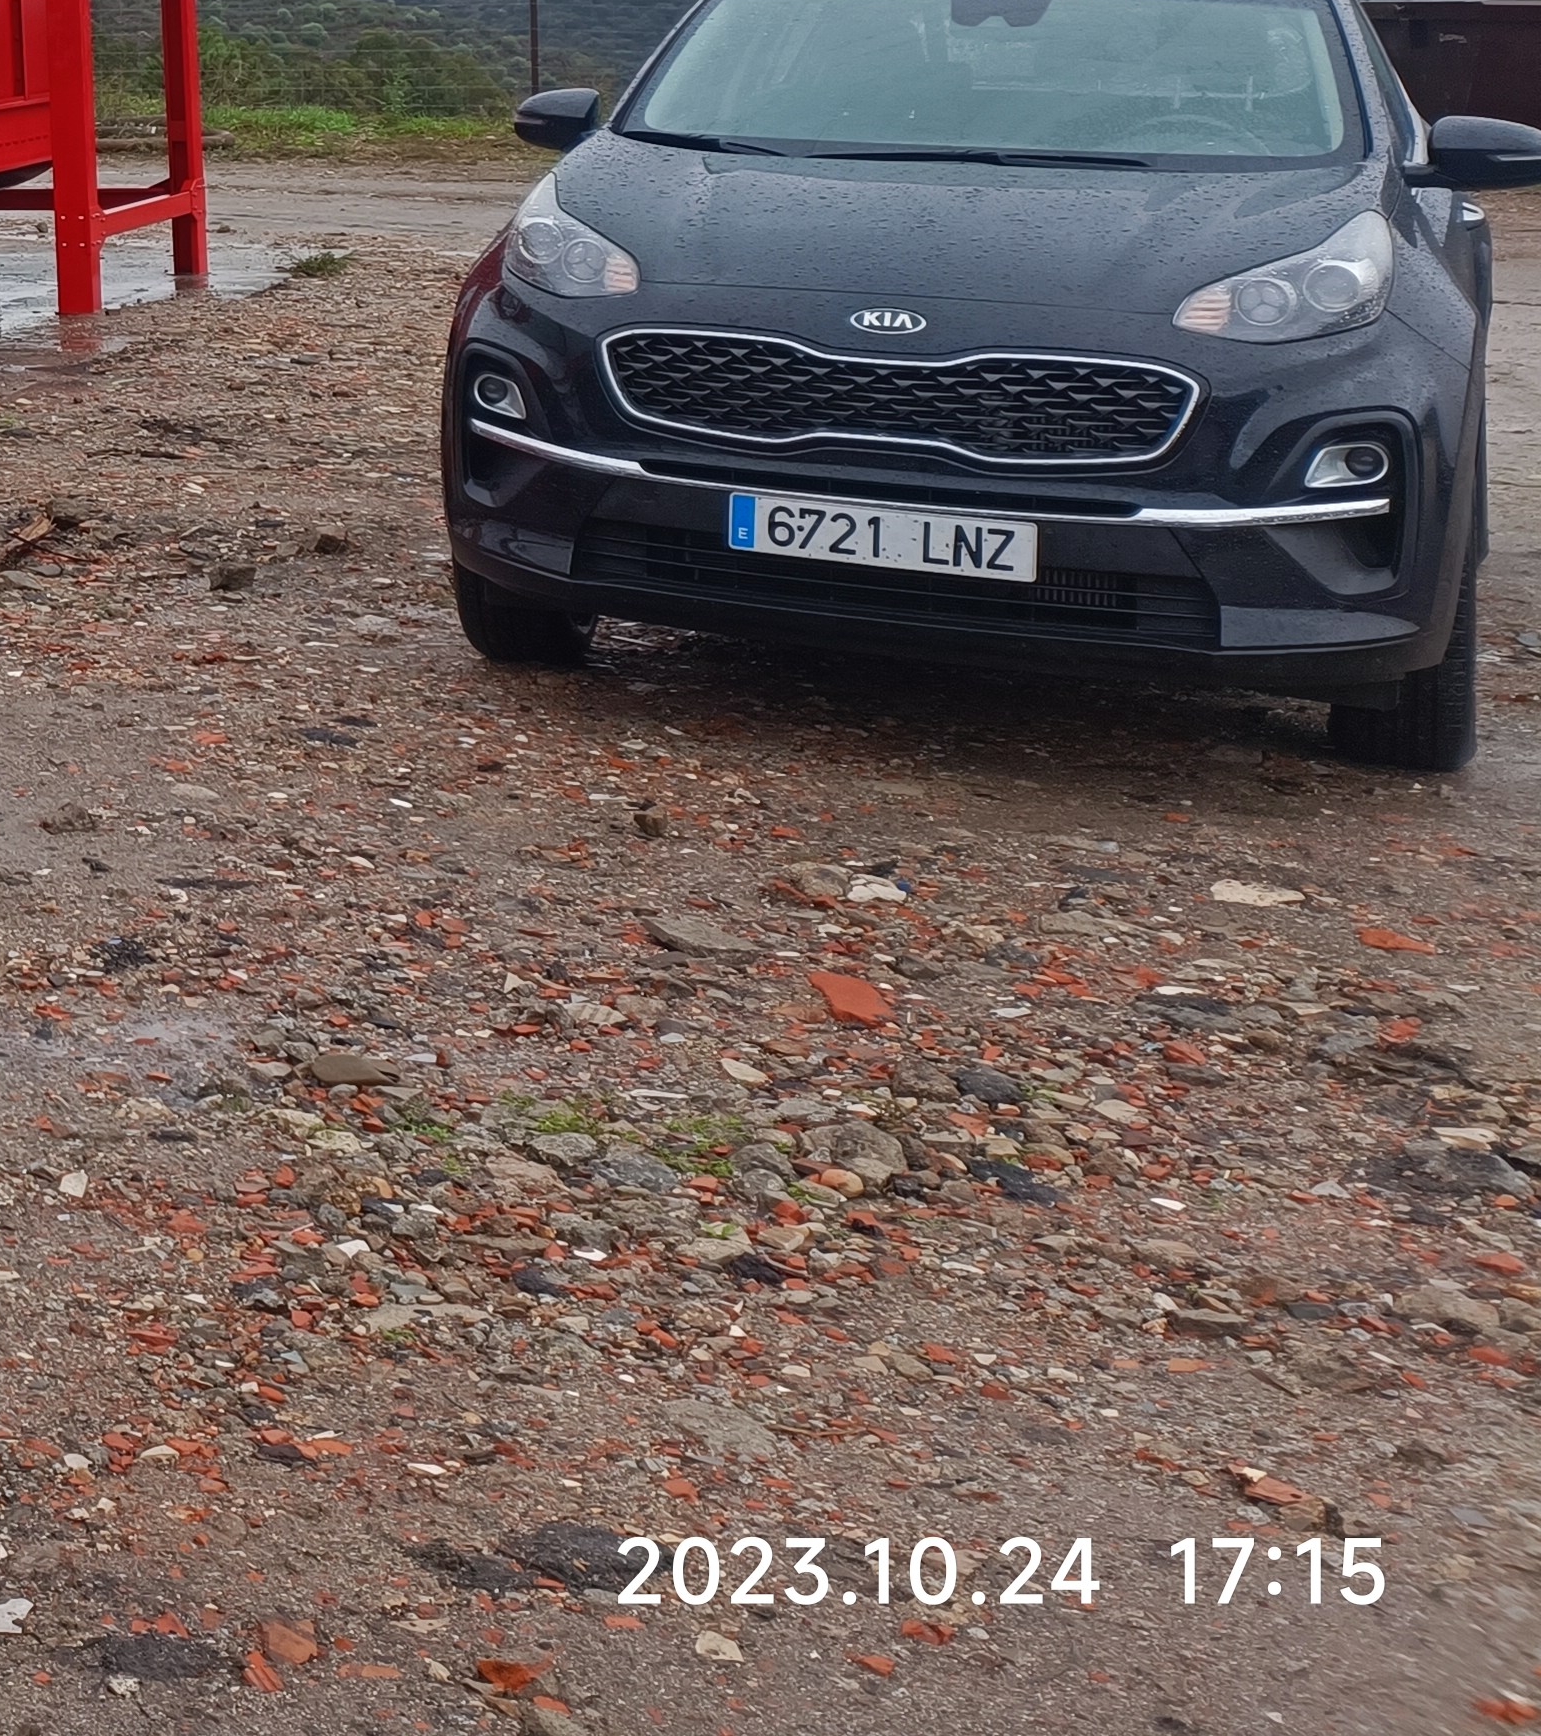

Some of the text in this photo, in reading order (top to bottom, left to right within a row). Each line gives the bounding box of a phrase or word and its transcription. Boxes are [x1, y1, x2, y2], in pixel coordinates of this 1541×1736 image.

[862, 311, 914, 329] KIA
[738, 527, 749, 540] E
[767, 505, 1016, 572] 6721 LNZ
